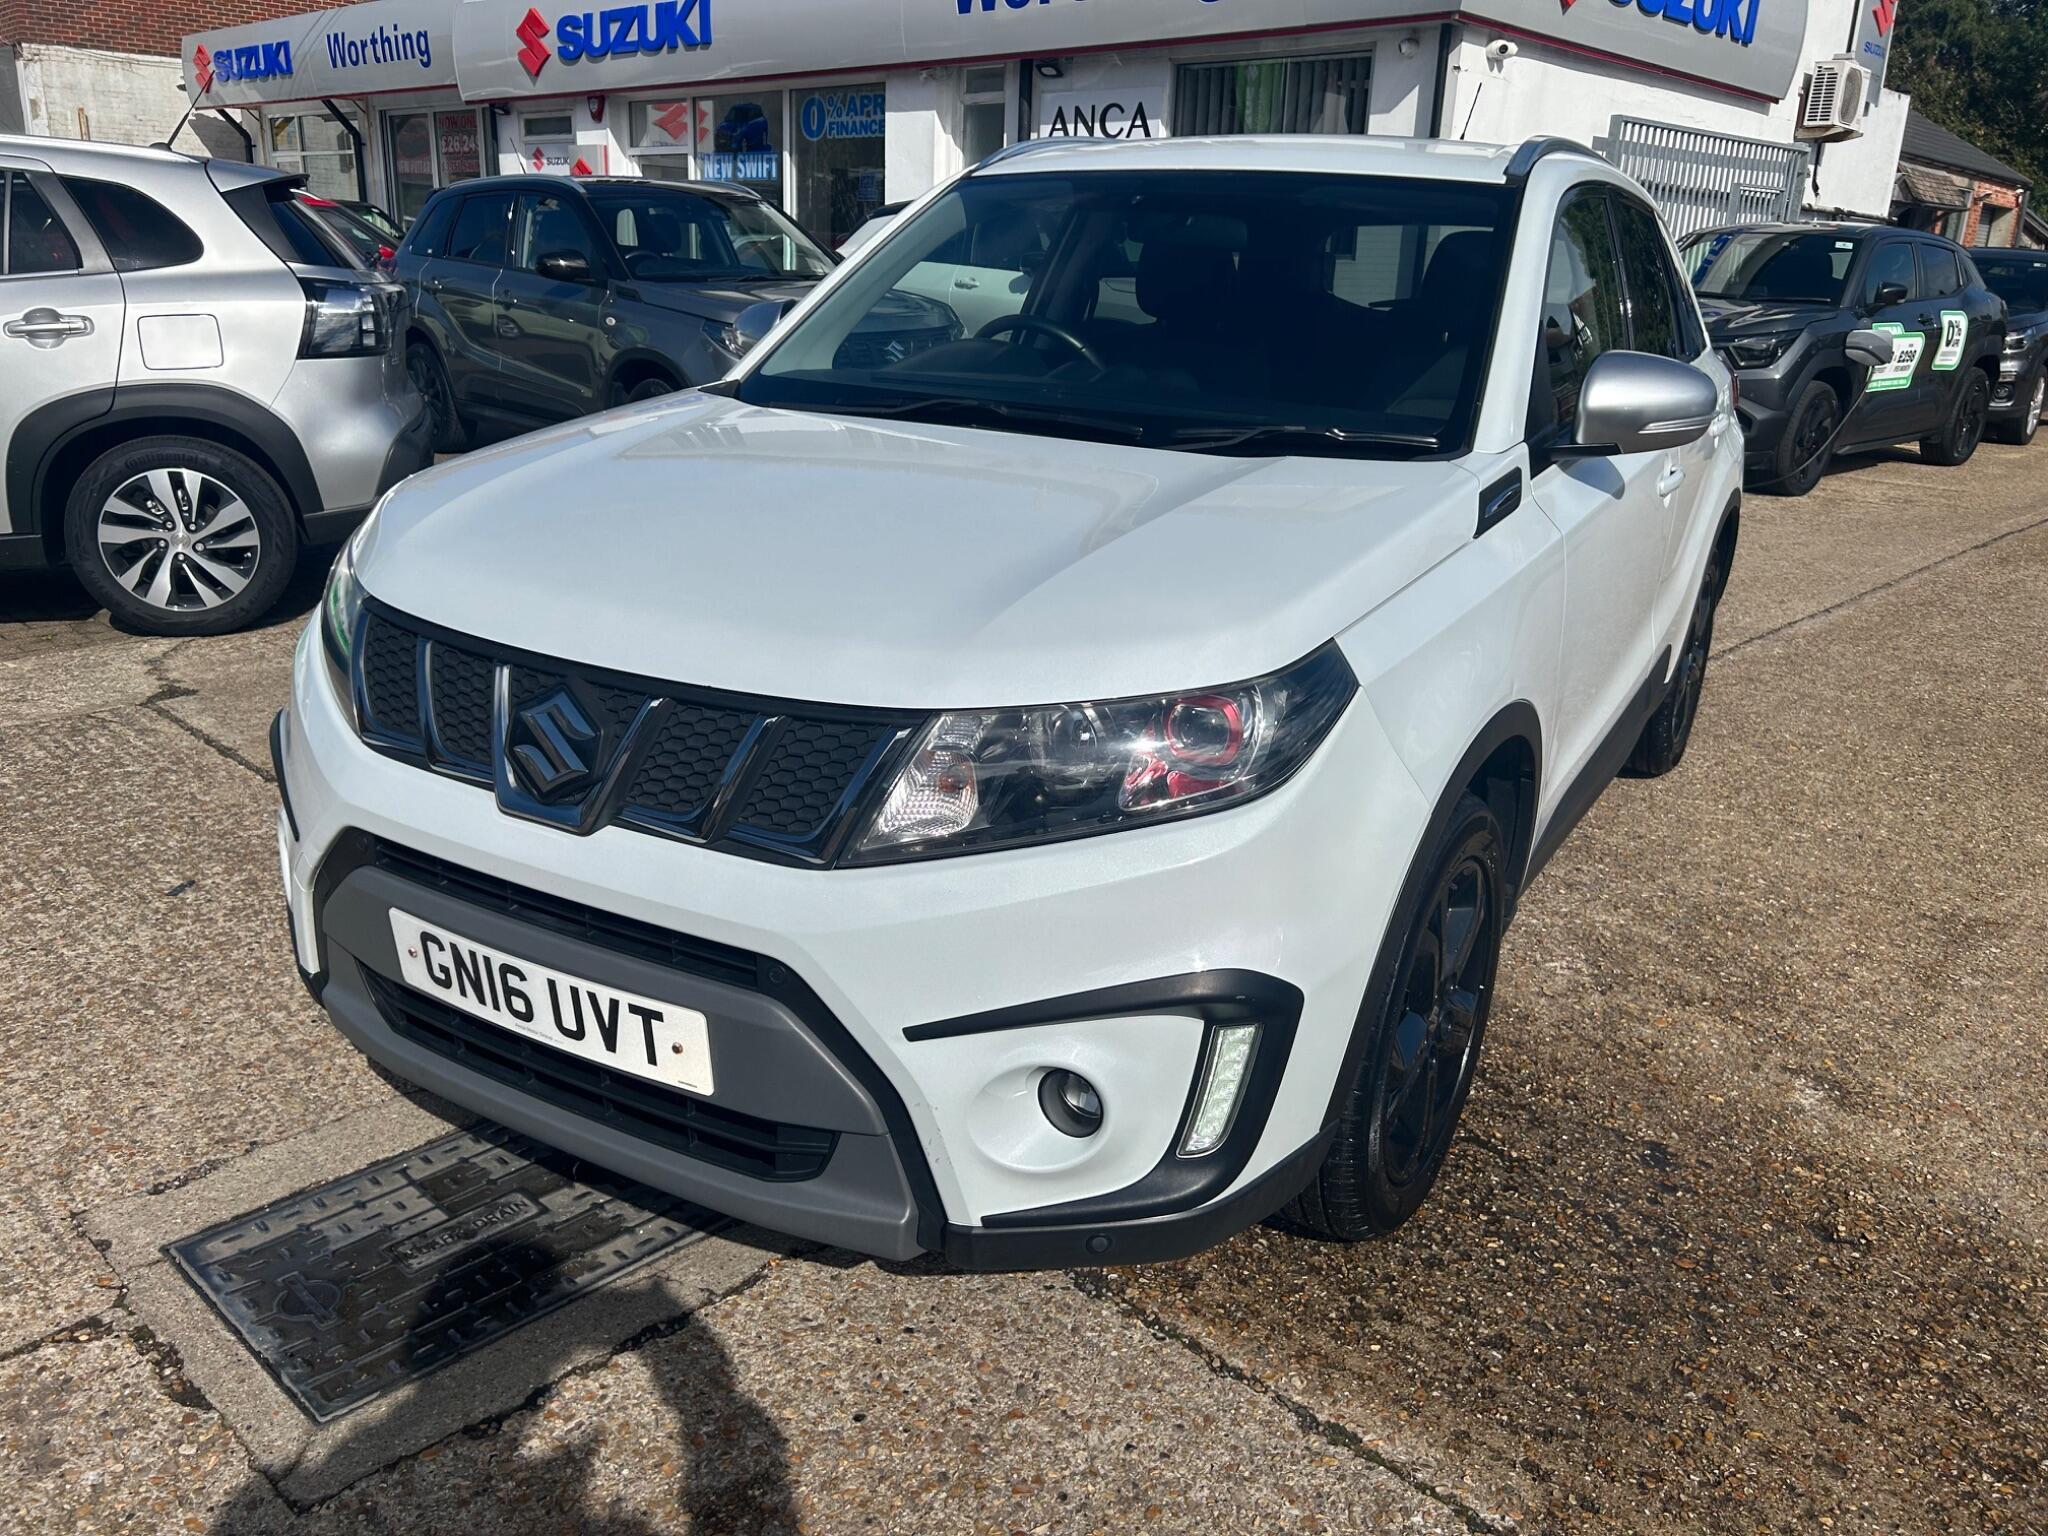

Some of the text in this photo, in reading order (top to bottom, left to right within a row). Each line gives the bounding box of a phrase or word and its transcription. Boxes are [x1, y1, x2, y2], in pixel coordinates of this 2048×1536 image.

[326, 24, 431, 68] Worthing
[557, 0, 712, 61] SUZUKI
[213, 40, 293, 82] SUZUKI
[845, 94, 886, 119] APR
[1049, 101, 1151, 138] ANCA
[827, 119, 886, 138] FINANCE
[704, 153, 778, 179] NEW SWIFT
[420, 931, 664, 1067] GN16 UVT
[472, 1199, 529, 1229] DRAIN
